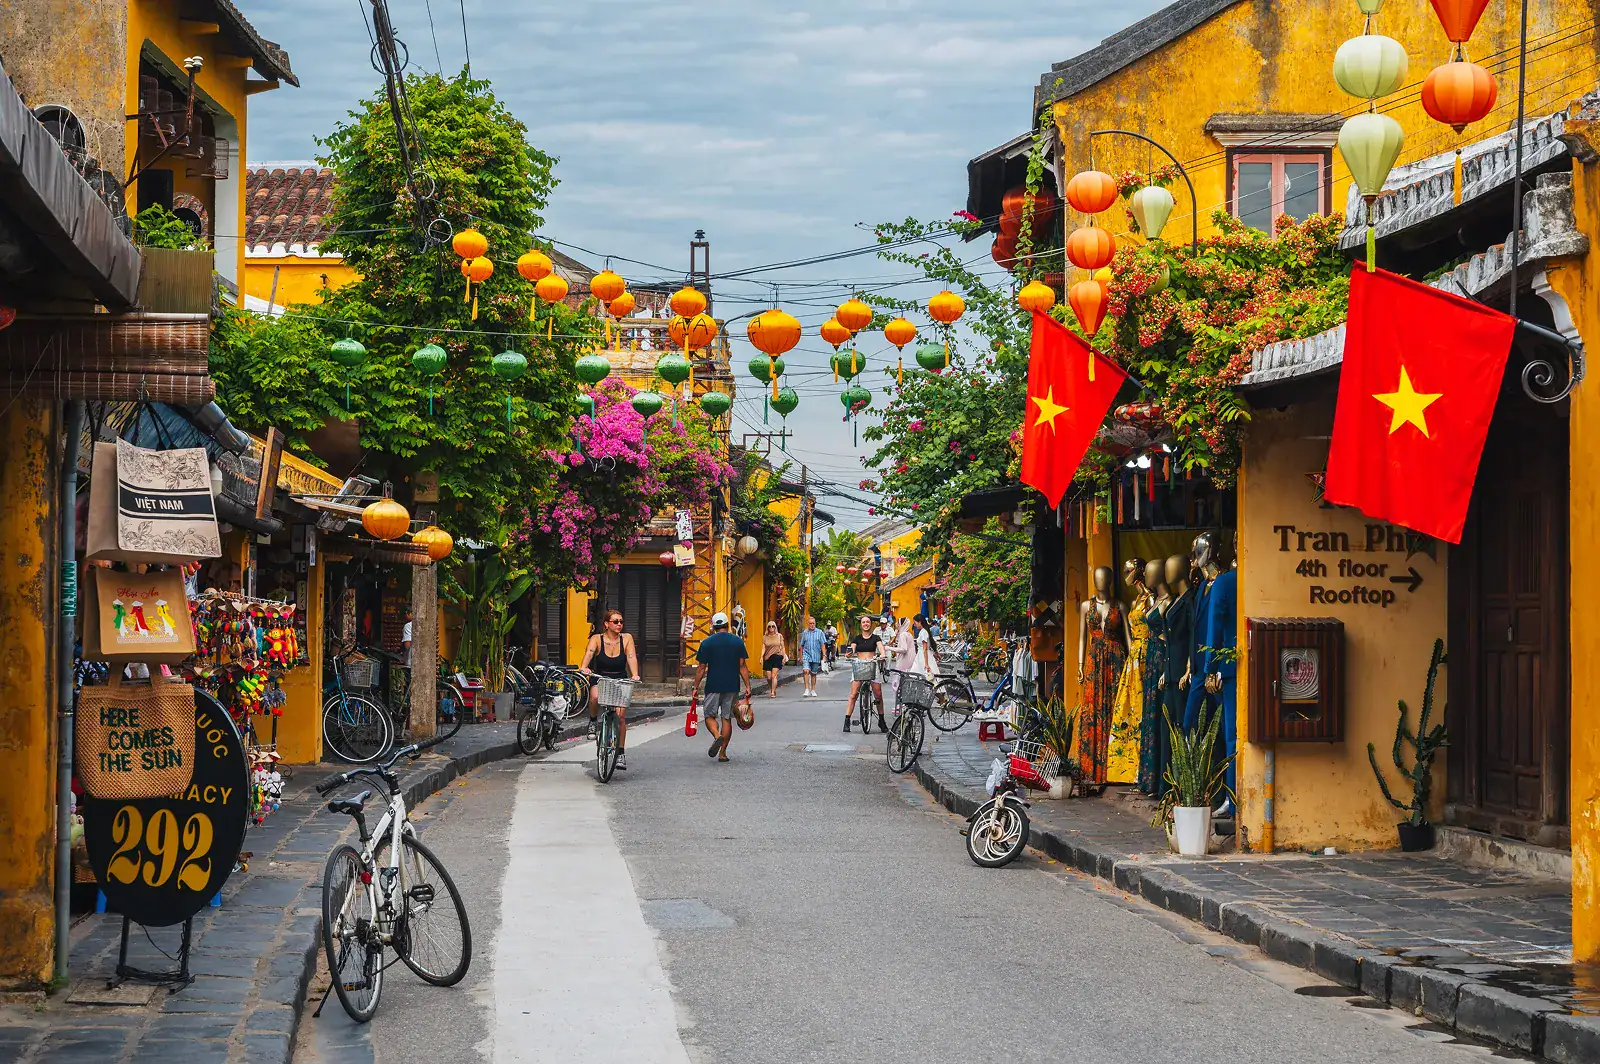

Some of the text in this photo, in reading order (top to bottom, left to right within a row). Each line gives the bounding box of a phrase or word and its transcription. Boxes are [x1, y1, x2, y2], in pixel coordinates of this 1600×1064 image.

[134, 497, 184, 511] VIỆT NAM
[1273, 525, 1349, 552] Tran
[1295, 558, 1388, 577] 4th floor
[1309, 585, 1395, 608] Rooftop
[684, 615, 695, 638] ATM
[100, 706, 141, 728] HERE
[108, 725, 176, 751] COMES
[98, 748, 183, 772] THE SUN
[107, 805, 213, 891] 292
